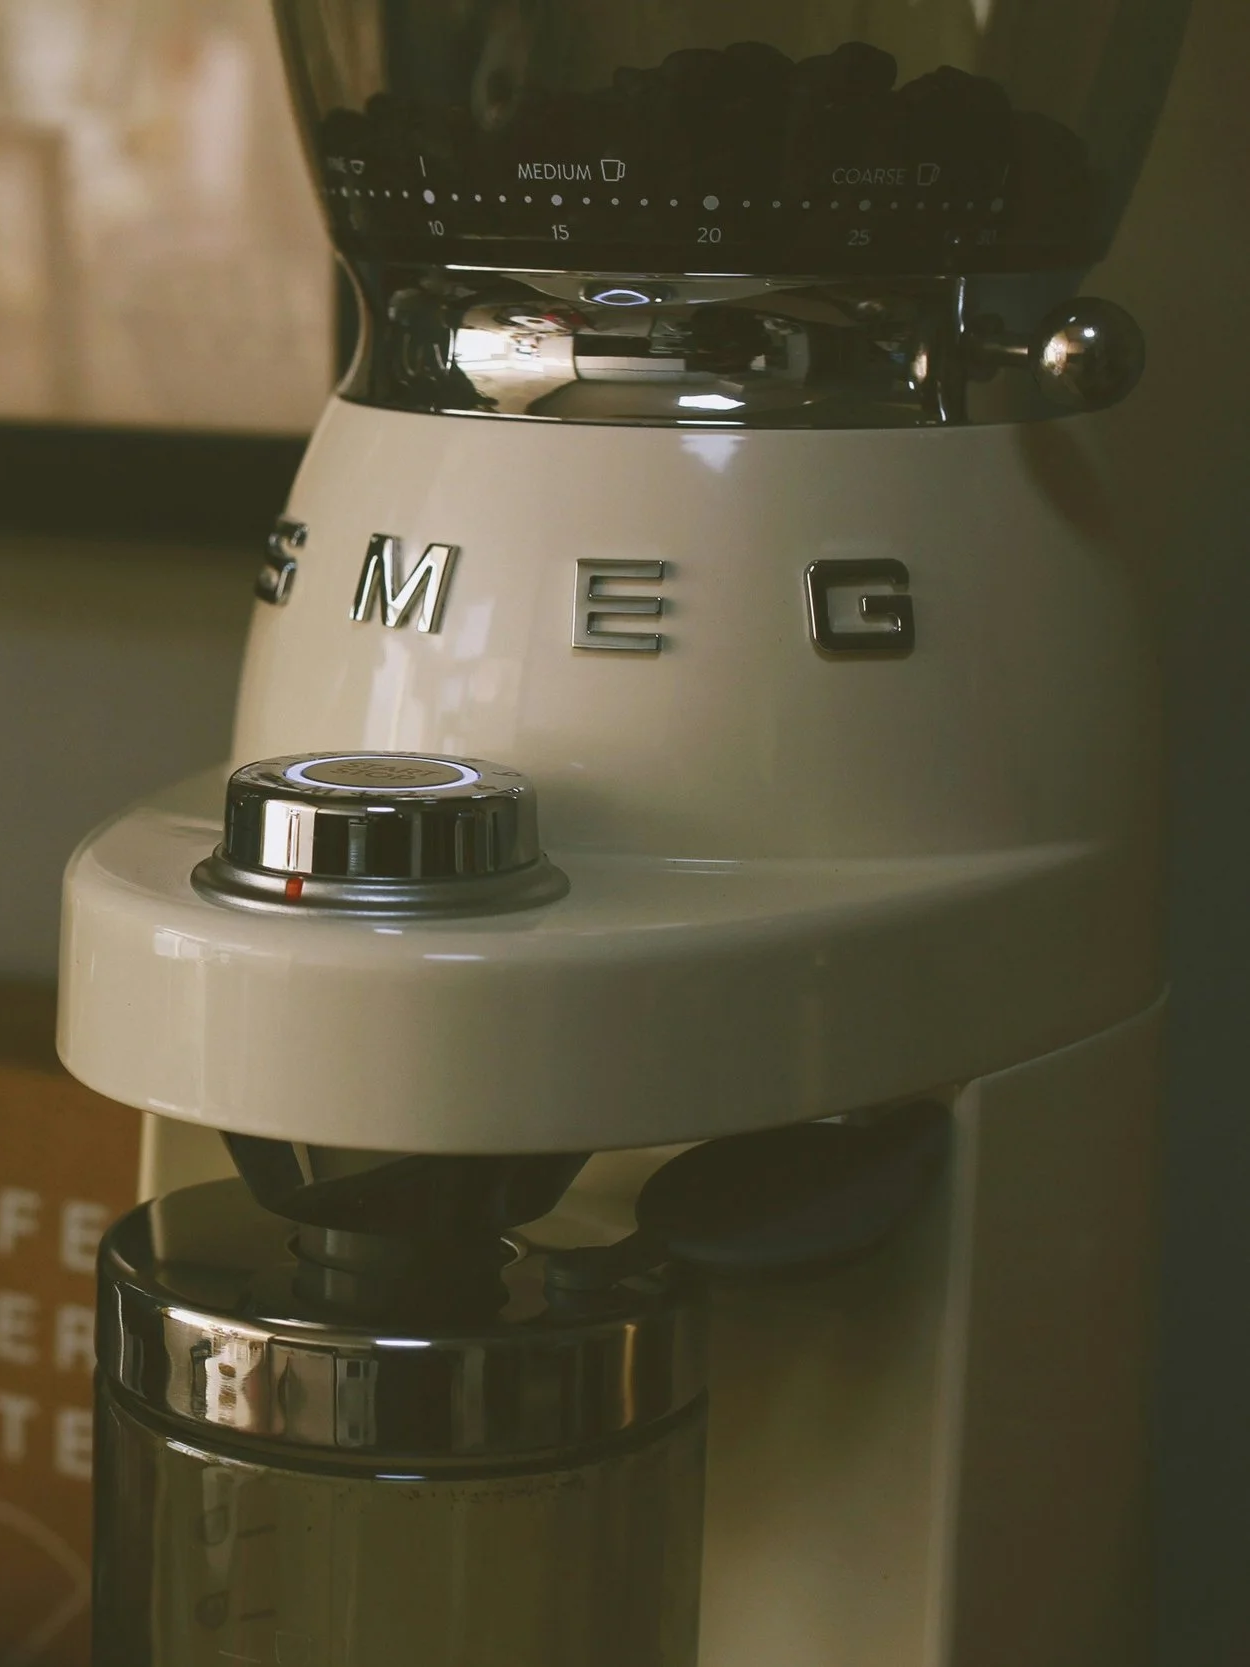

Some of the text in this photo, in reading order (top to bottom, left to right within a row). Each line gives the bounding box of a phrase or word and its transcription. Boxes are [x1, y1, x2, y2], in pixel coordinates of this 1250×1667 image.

[517, 163, 592, 181] MEDIUM
[832, 167, 907, 186] COARSE
[427, 220, 445, 237] 10
[551, 224, 570, 241] 15
[696, 227, 722, 244] 20
[847, 229, 871, 246] 25
[255, 521, 915, 655] SMEG
[329, 768, 417, 780] STOP
[341, 762, 440, 777] START
